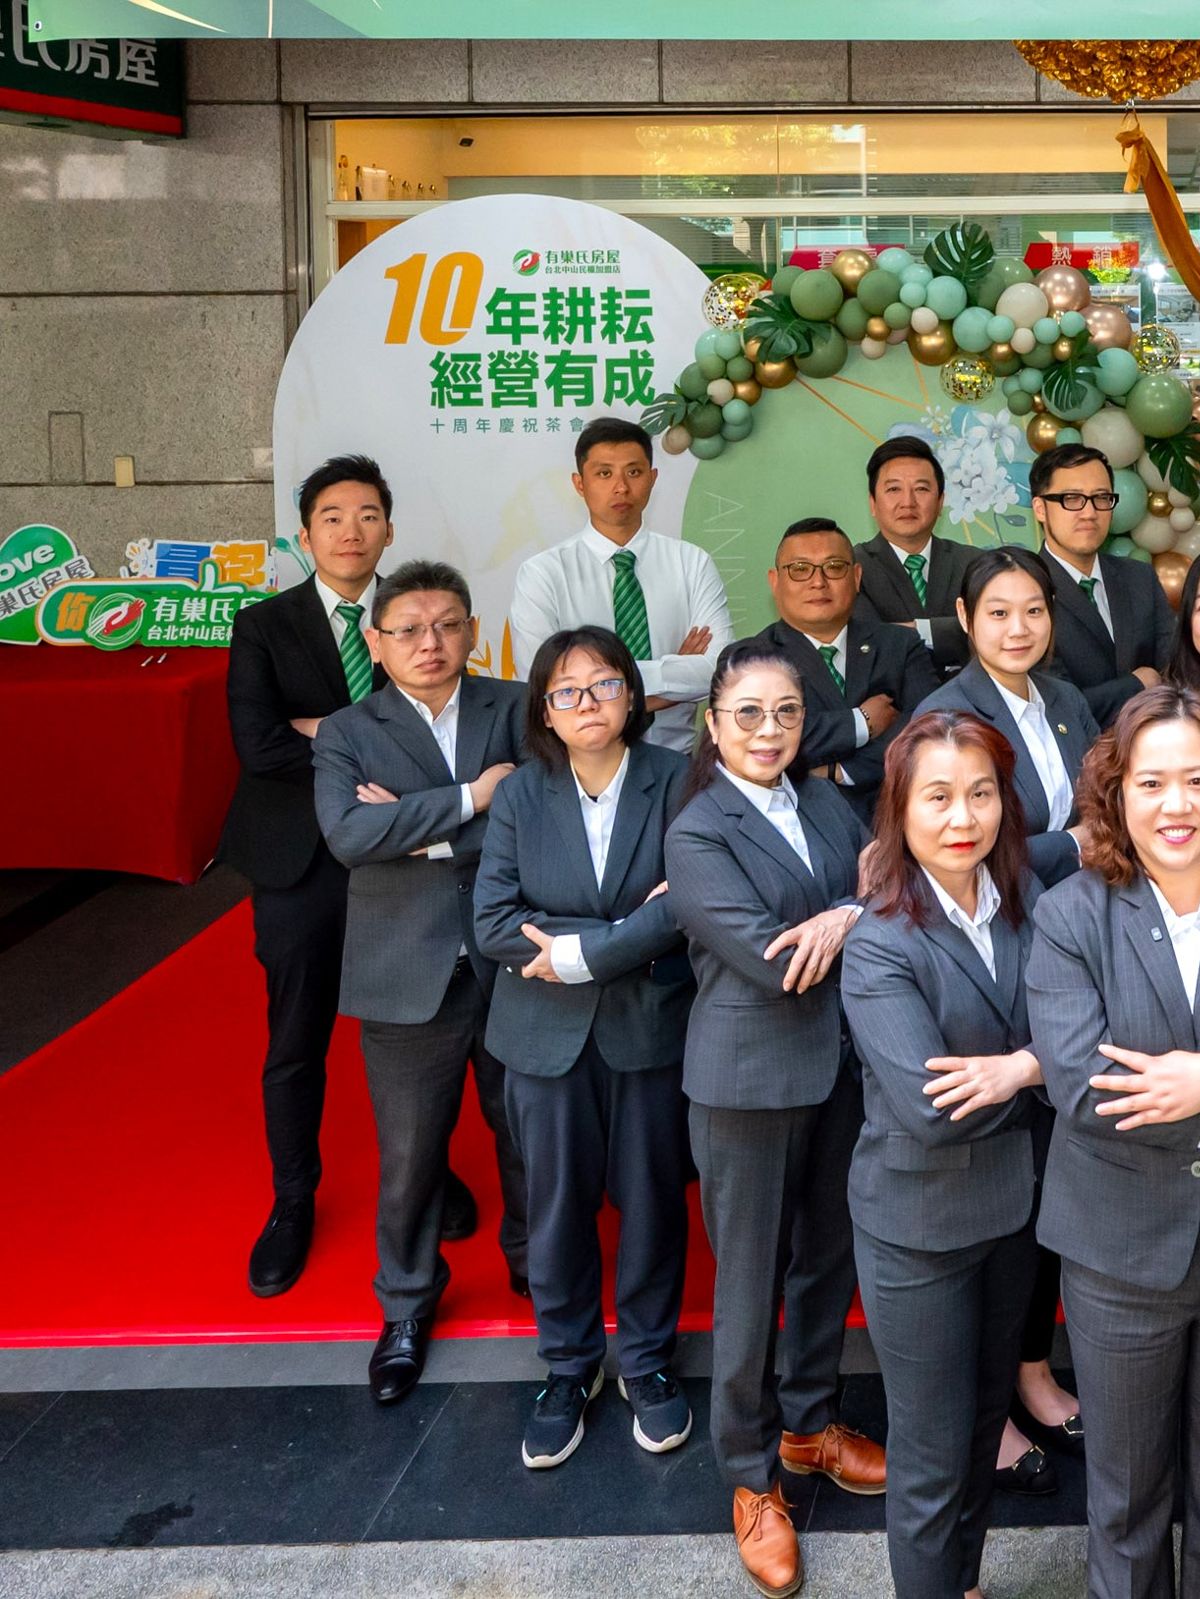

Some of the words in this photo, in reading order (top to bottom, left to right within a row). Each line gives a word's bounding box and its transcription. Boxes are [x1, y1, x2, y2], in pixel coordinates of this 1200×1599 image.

[0, 0, 159, 87] 氏房屋
[545, 249, 621, 264] 有巢氏房屋
[428, 349, 656, 409] 經營有成
[430, 416, 586, 434] 十周年慶祝茶會
